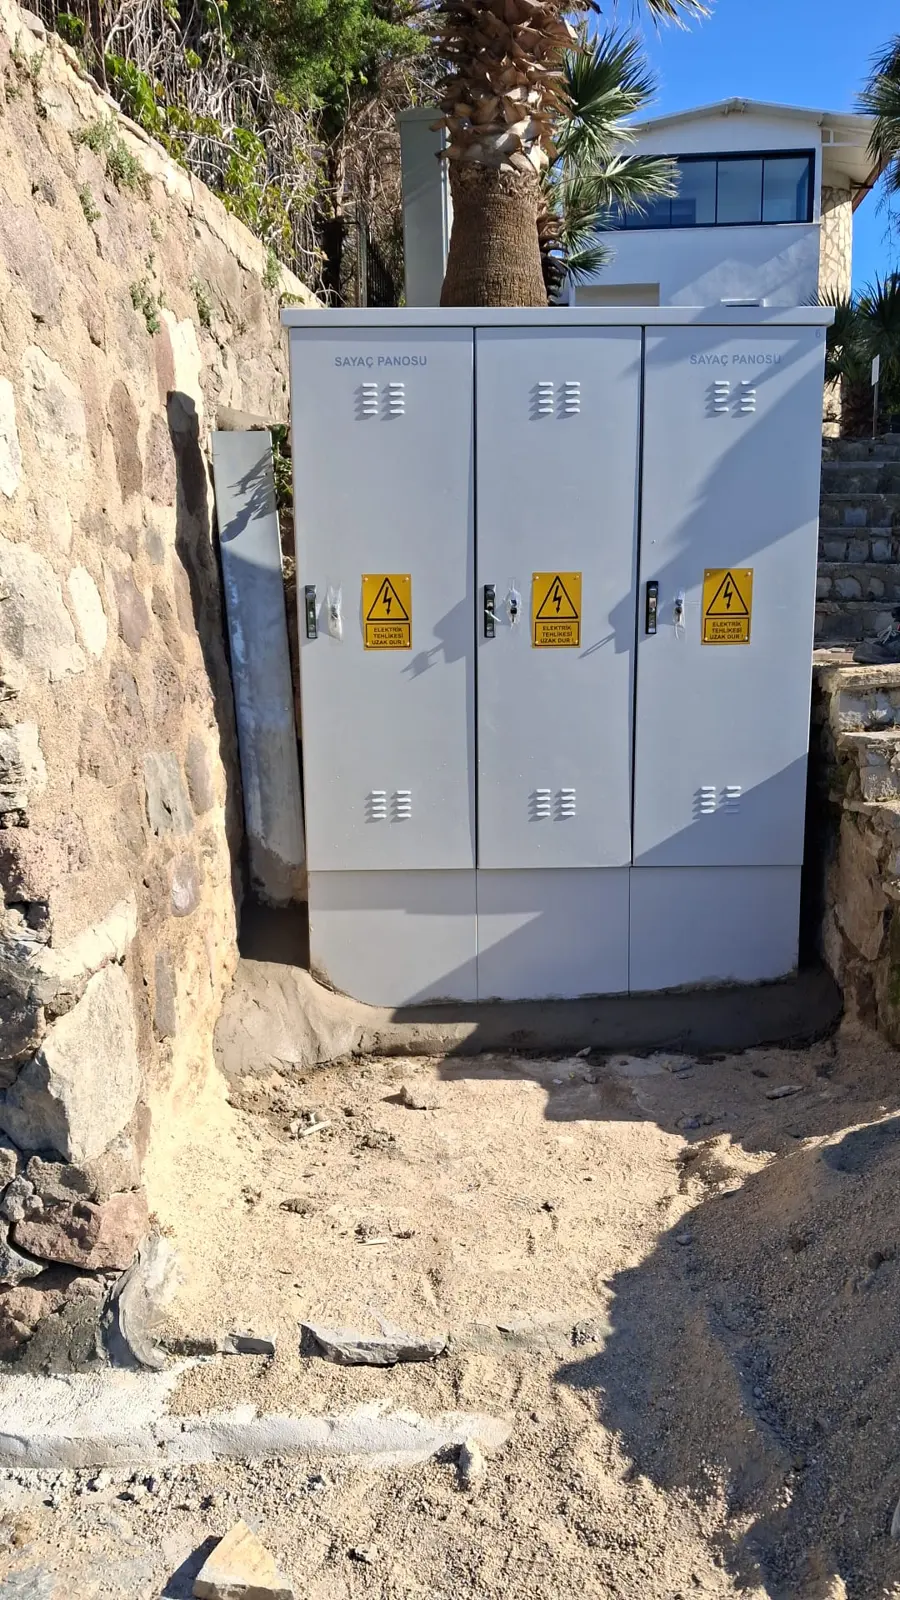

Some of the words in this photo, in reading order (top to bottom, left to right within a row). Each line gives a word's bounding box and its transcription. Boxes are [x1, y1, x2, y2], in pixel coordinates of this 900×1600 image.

[334, 356, 374, 368] SAYAÇ
[377, 356, 427, 366] PANOSU
[690, 354, 728, 366] SAYAÇ
[732, 354, 781, 365] PANOSU
